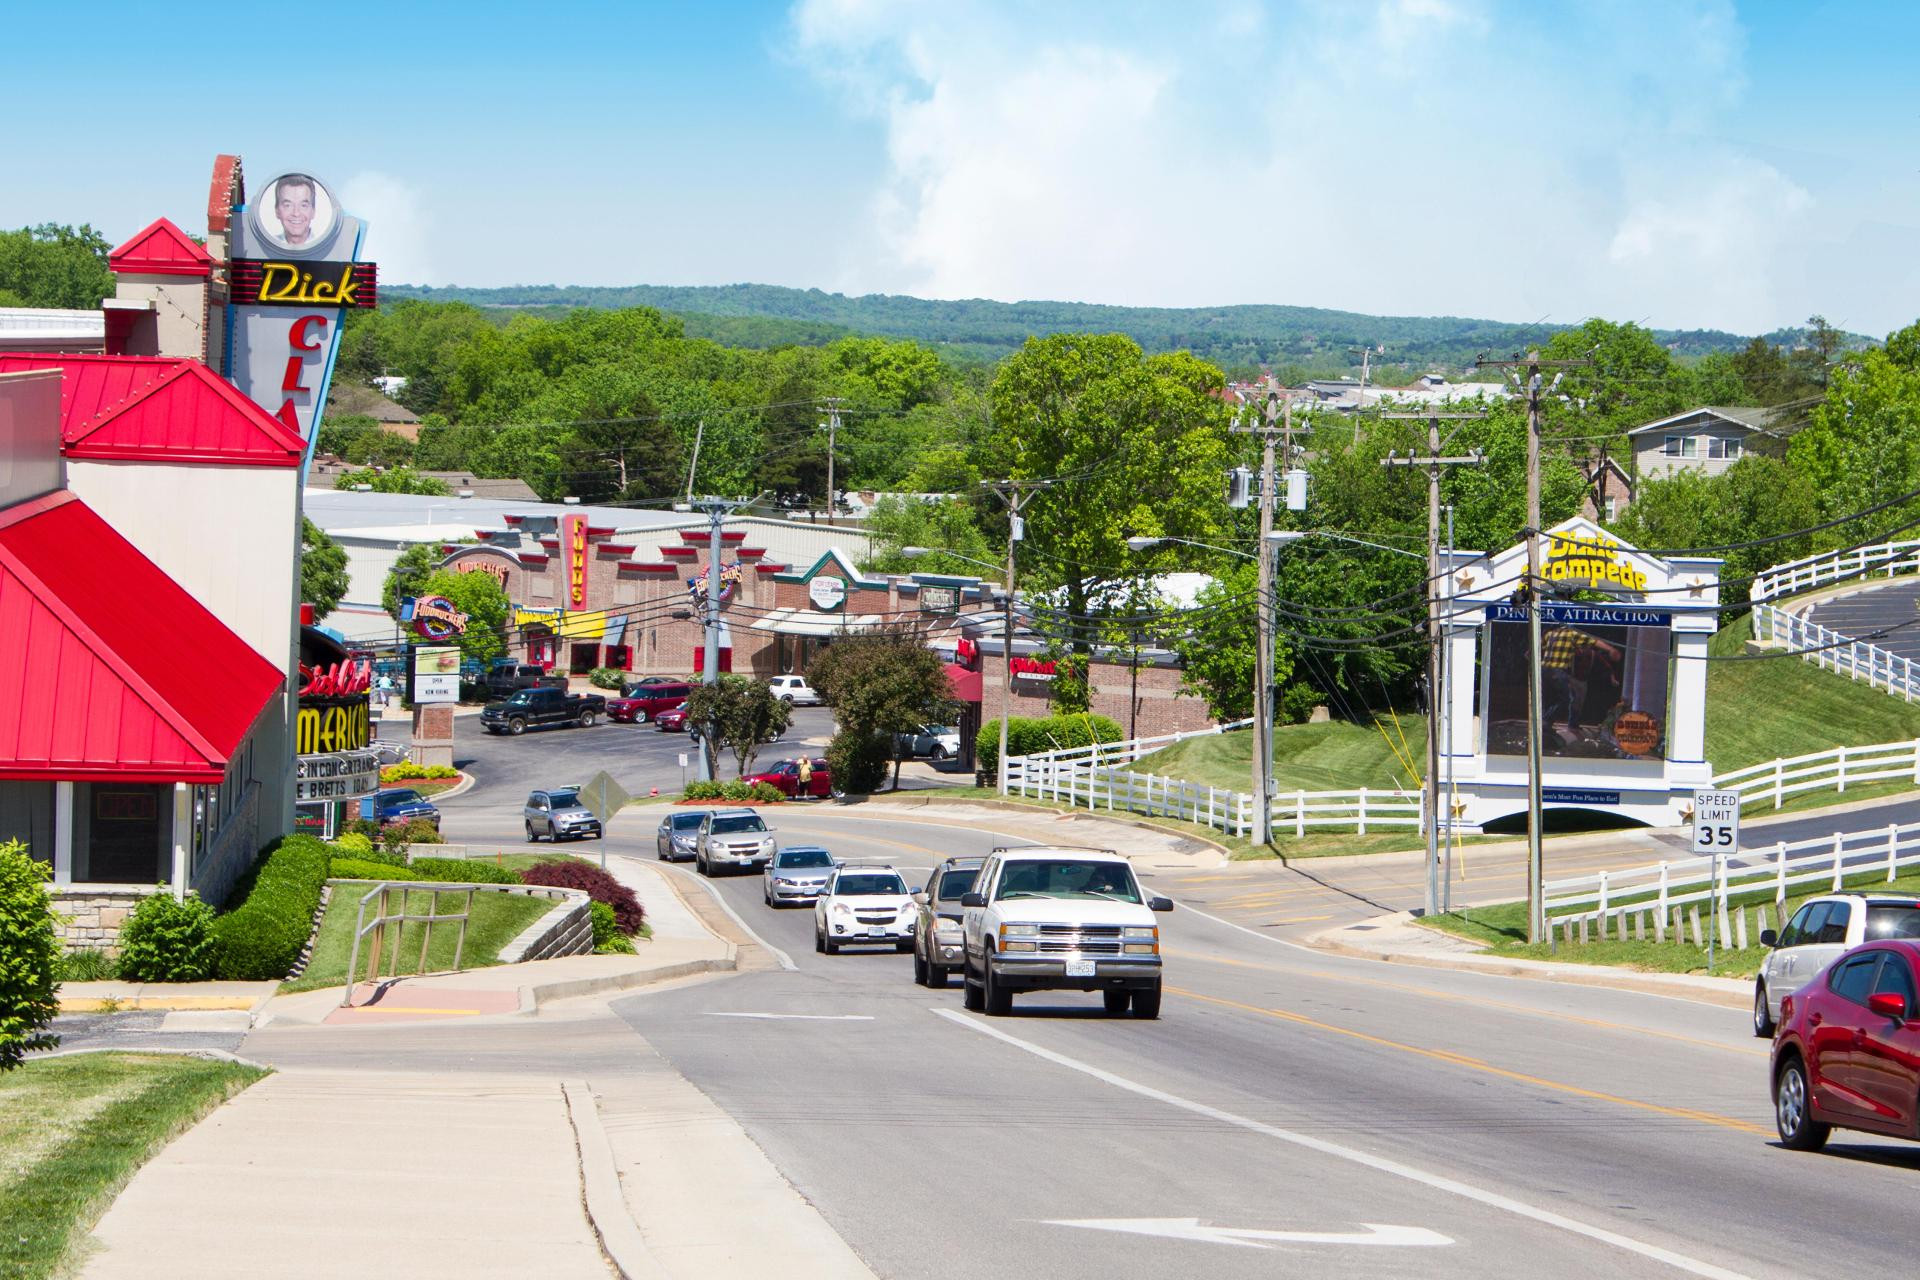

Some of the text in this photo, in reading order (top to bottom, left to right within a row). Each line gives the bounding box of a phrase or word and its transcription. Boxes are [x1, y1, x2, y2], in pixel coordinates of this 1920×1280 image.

[258, 262, 361, 303] Dick
[1547, 531, 1618, 559] Dixie
[1497, 607, 1659, 622] DINER ATTRACTION
[310, 781, 346, 797] BRETTS
[1698, 795, 1736, 806] SPEED
[1701, 810, 1732, 821] LIMIT
[1698, 826, 1733, 846] 35
